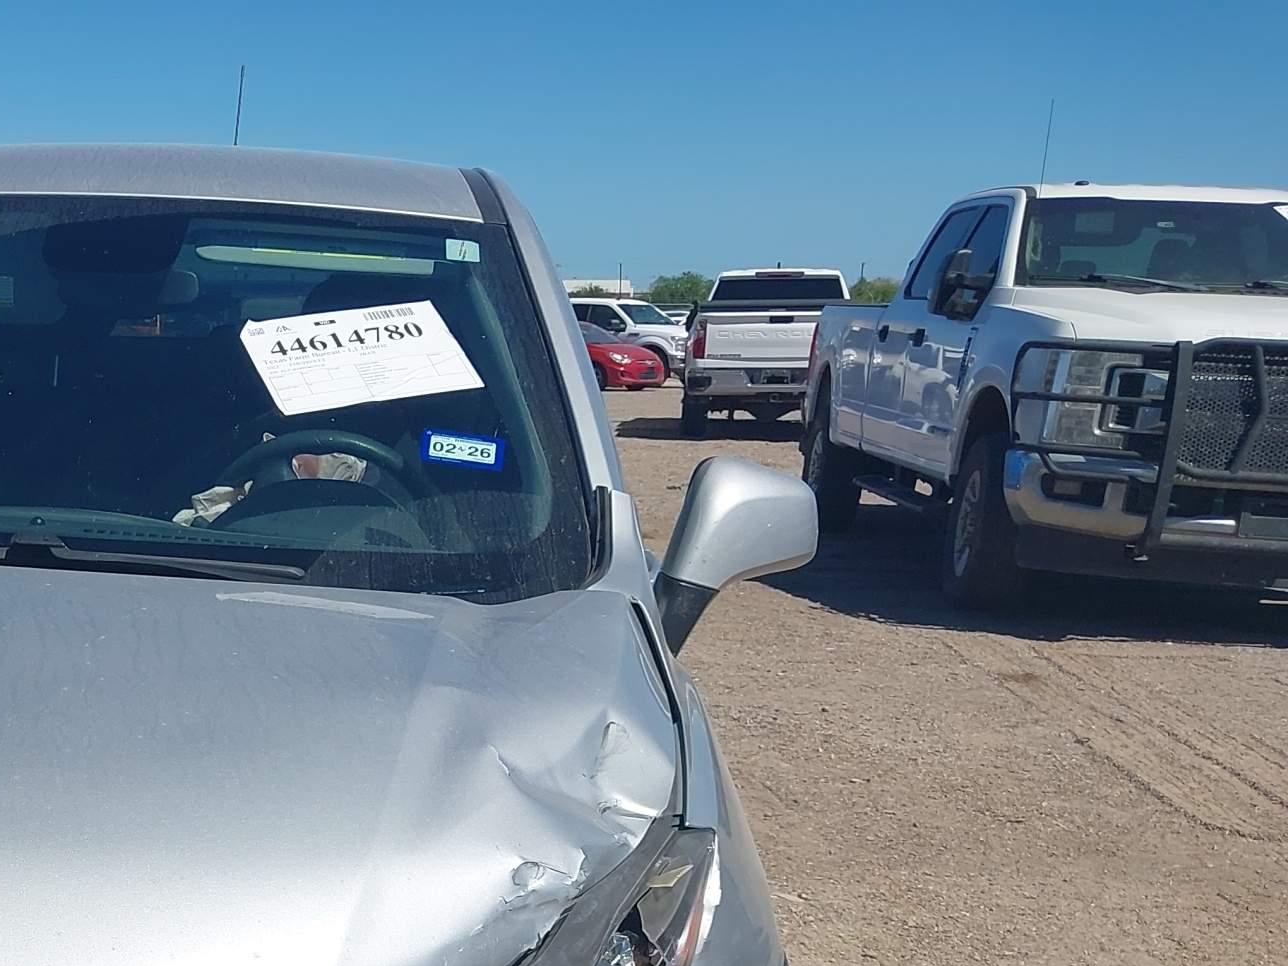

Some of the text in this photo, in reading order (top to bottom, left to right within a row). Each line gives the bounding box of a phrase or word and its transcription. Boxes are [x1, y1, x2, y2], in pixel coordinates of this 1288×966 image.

[270, 321, 423, 356] 44614780
[432, 441, 457, 454] 02
[466, 446, 491, 459] 26
